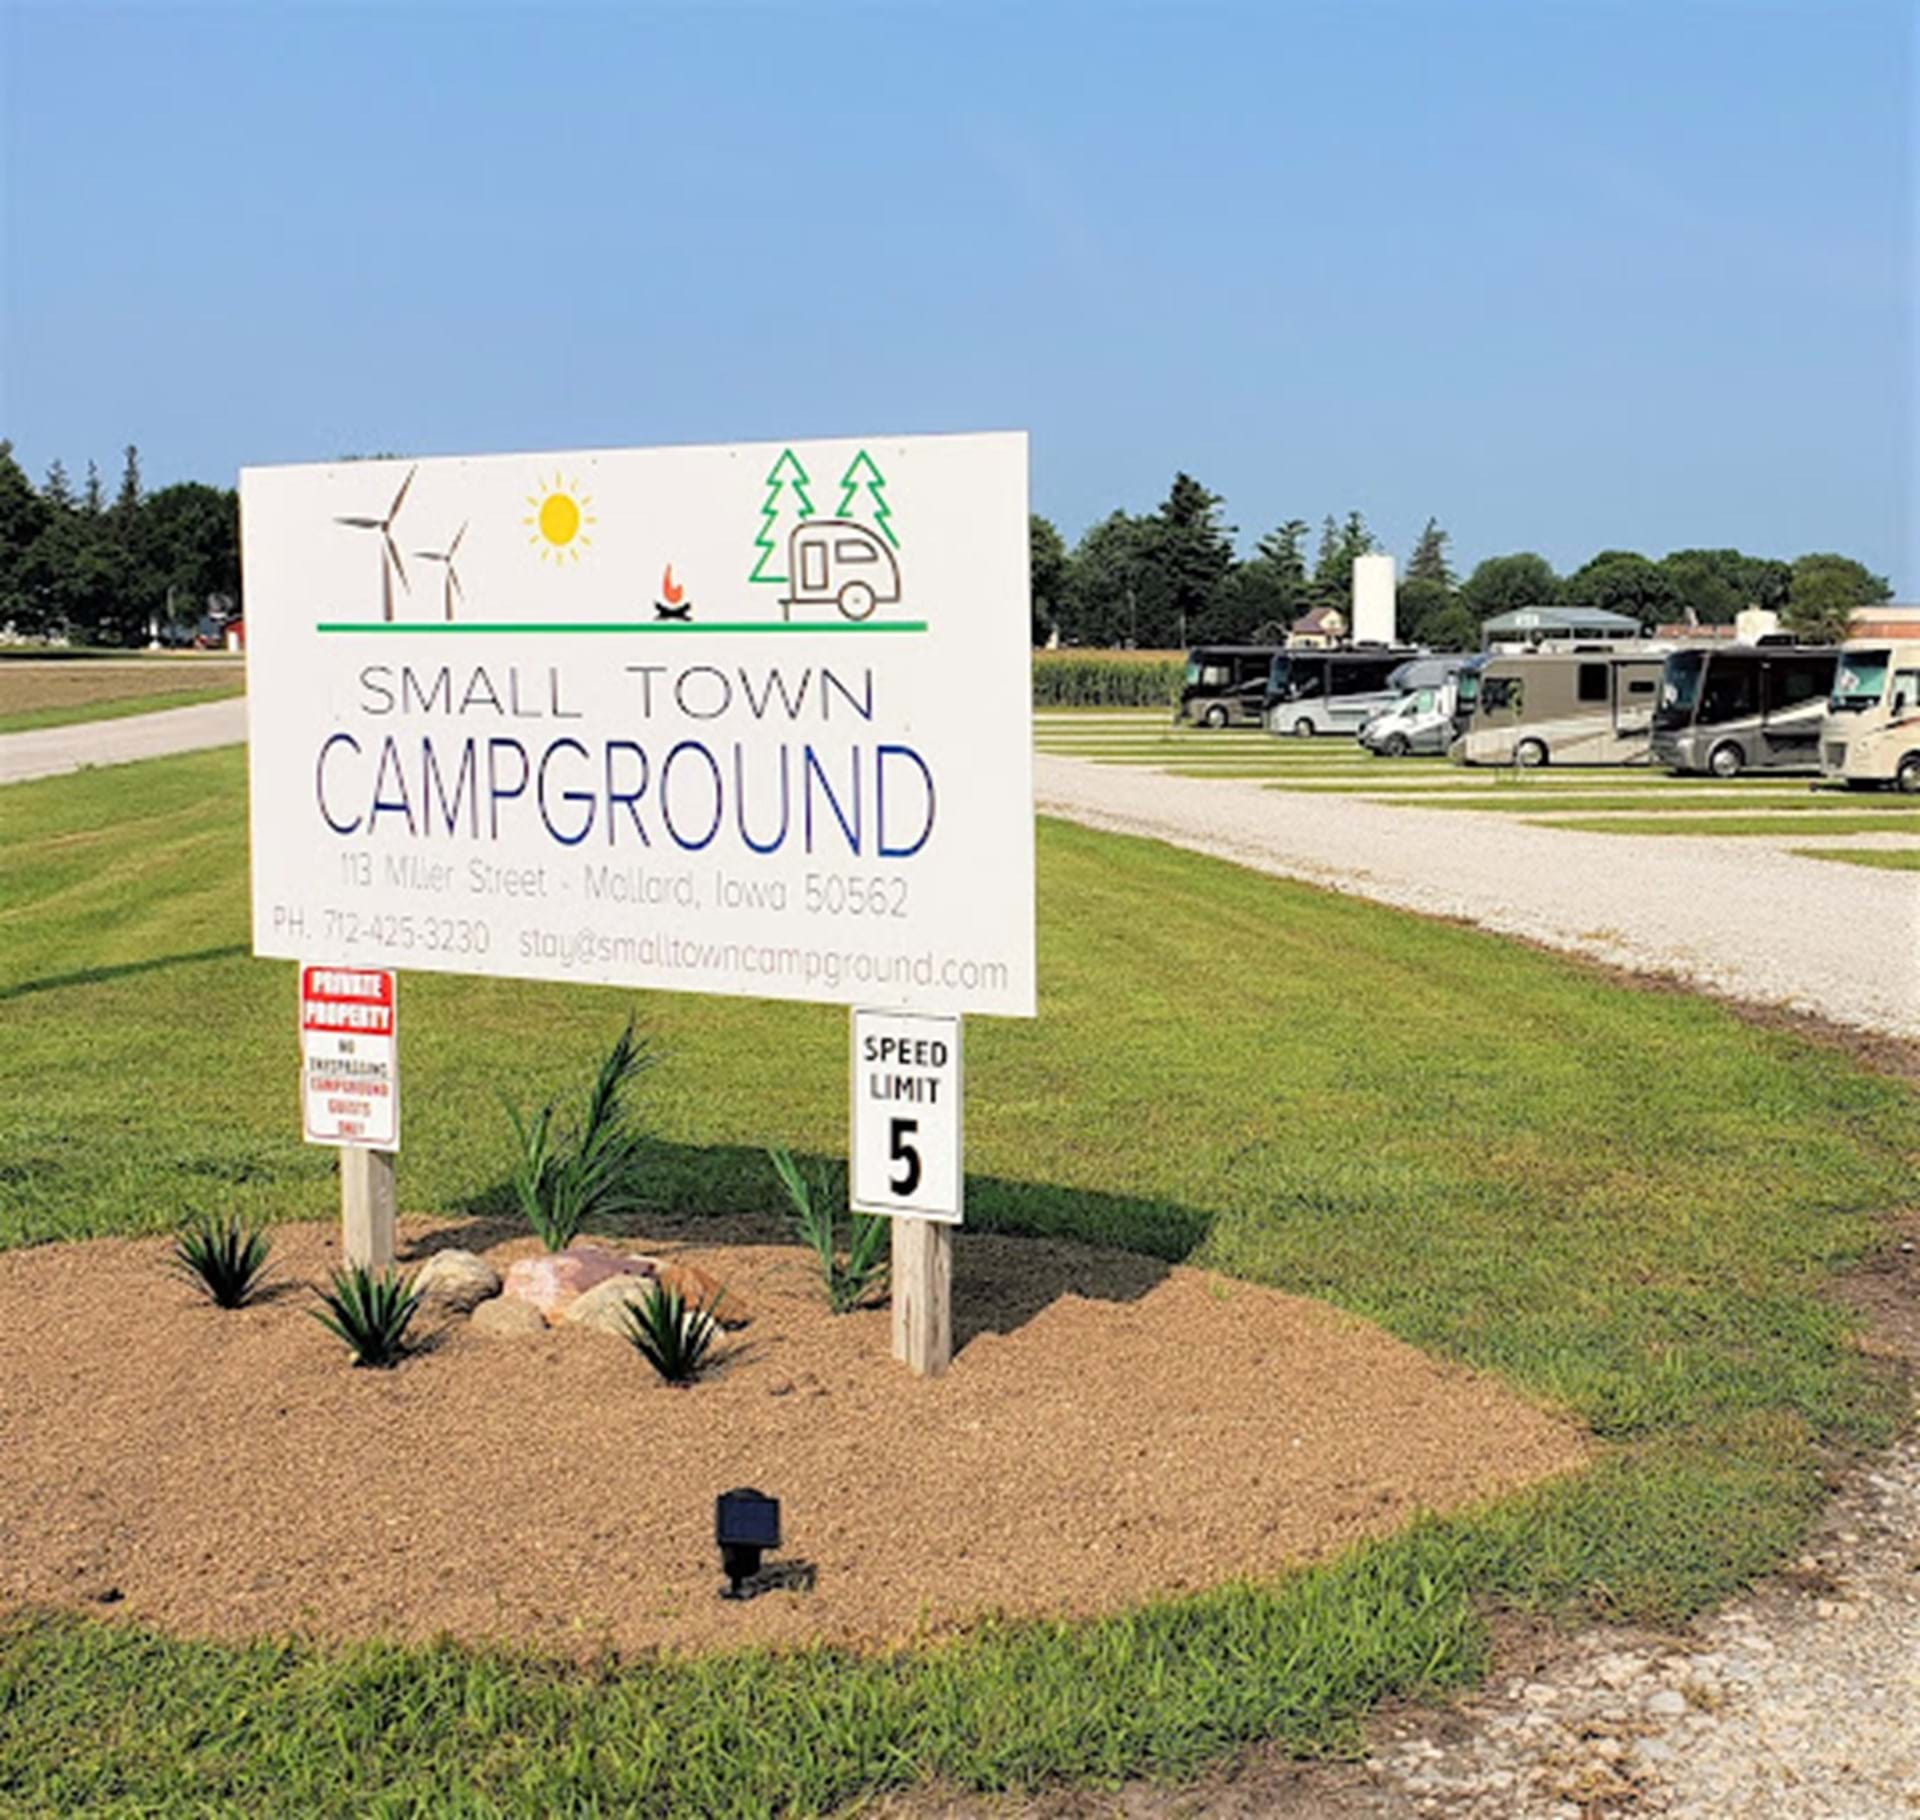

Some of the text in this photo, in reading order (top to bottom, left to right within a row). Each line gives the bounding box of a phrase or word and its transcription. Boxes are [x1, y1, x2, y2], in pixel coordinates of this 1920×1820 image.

[359, 664, 875, 721] SMALL TOWN
[315, 732, 936, 858] CAMPGROUND
[341, 852, 372, 887] 113
[386, 855, 453, 892] Miller
[467, 859, 547, 898] Street
[584, 865, 701, 909] Mallard,
[715, 872, 787, 911] Iowa
[805, 874, 908, 917] 50562
[273, 904, 1009, 989] PH. 712-425-3230 stay@smalltowncampground.com
[312, 970, 385, 998] PRIVATE
[305, 1002, 391, 1029] PROPERTY
[864, 1035, 948, 1067] SPEED
[870, 1073, 940, 1104] LIMIT
[889, 1117, 922, 1197] 5
